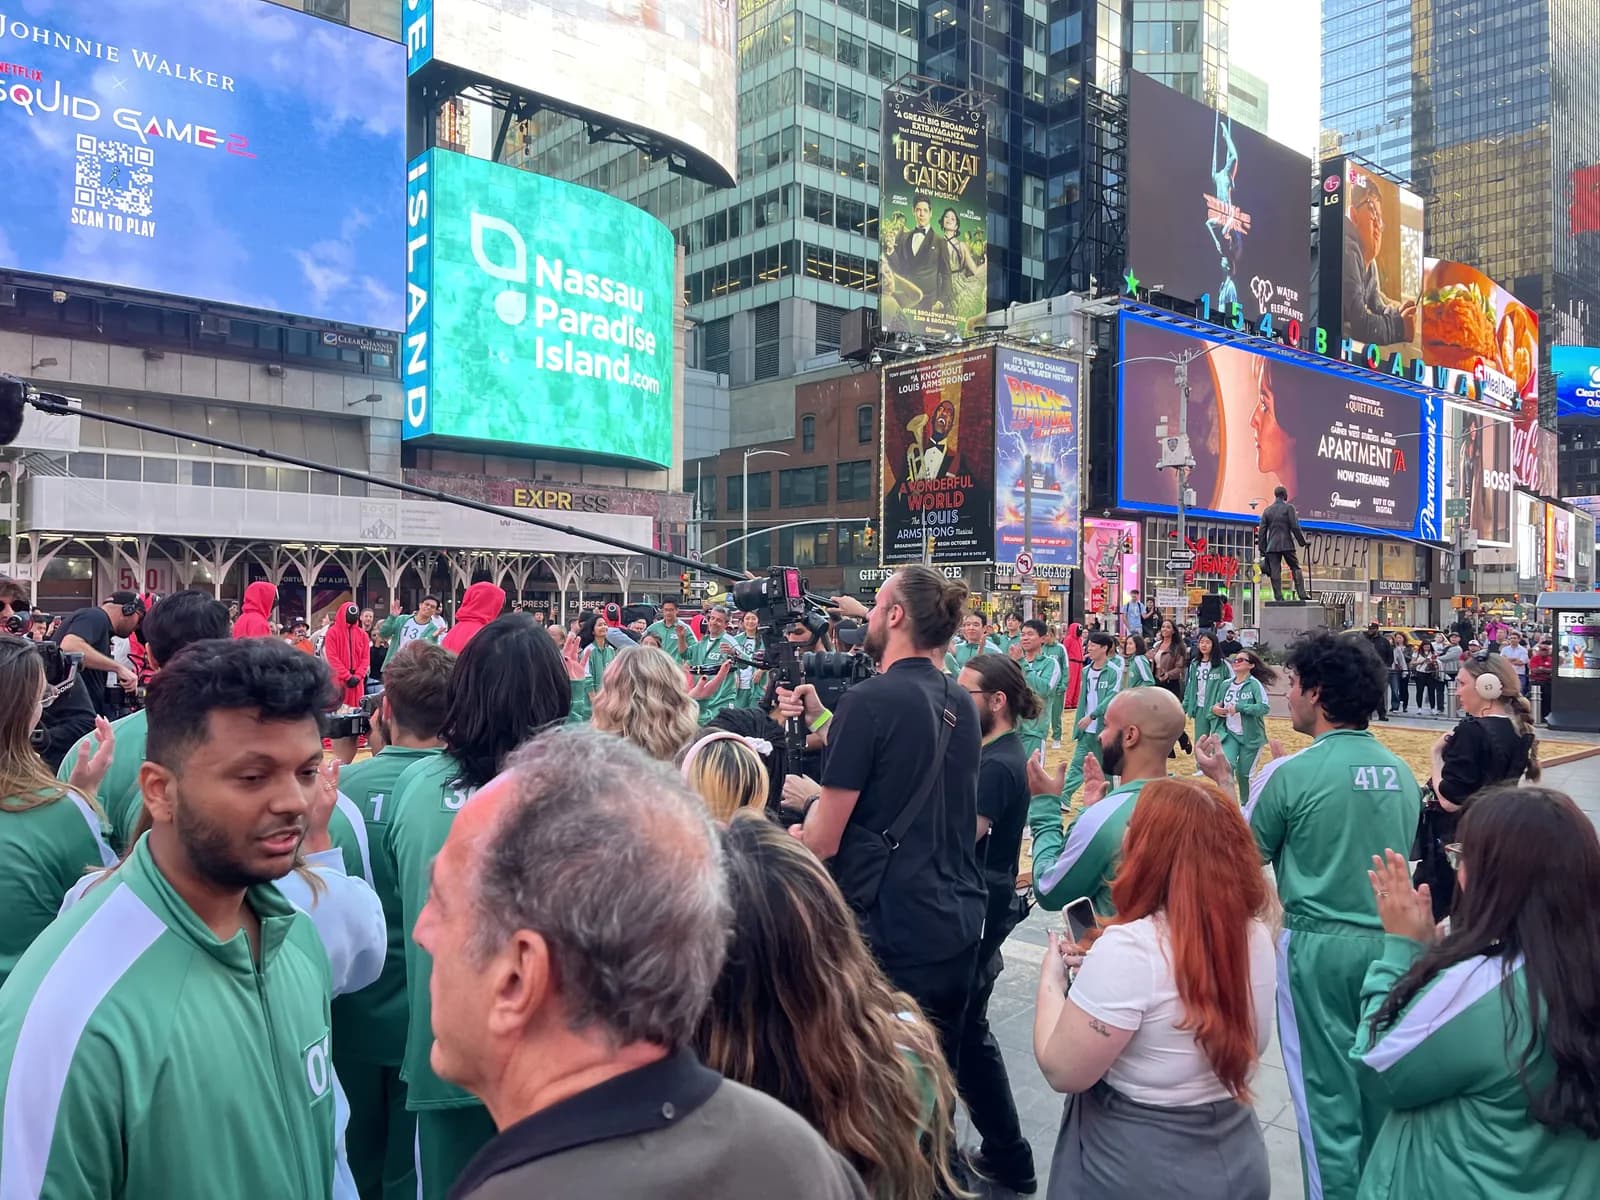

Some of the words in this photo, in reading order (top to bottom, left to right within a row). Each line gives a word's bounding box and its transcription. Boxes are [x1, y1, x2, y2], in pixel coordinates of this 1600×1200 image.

[0, 13, 119, 63] JOHNNIE
[131, 48, 235, 93] WALKER
[0, 79, 101, 121] SQUID
[112, 108, 225, 151] GAME
[911, 122, 965, 141] EXTRAVAGANZA
[928, 117, 940, 127] BIG
[940, 120, 978, 136] BROADWAY
[895, 139, 922, 164] THE
[926, 146, 980, 177] GREAT
[903, 163, 971, 195] GATSBY
[1356, 173, 1367, 188] LG
[934, 191, 960, 202] MUSICAL
[1324, 193, 1339, 206] LG
[71, 207, 104, 230] SCAN
[107, 212, 123, 233] TO
[127, 216, 156, 238] PLAY
[407, 161, 428, 429] ISLAND
[535, 254, 644, 314] Nassau
[1276, 285, 1299, 303] WATER
[1270, 303, 1304, 322] ELEPHANTS
[535, 295, 656, 356] Paradise
[921, 366, 962, 381] KNOCKOUT
[1003, 361, 1028, 374] MUSICAL
[1052, 372, 1075, 383] HISTORY
[898, 383, 920, 394] LOUIS
[1003, 374, 1072, 411] BACK
[1025, 407, 1072, 429] FUTURE
[1349, 400, 1367, 414] QUIET
[1367, 404, 1384, 417] PLACE
[1317, 434, 1393, 469] APARTMENT
[1393, 448, 1407, 475] 7A
[1337, 469, 1355, 482] NOW
[1355, 471, 1390, 488] STREAMING
[1420, 396, 1438, 540] Paramount+
[899, 483, 908, 494] A
[908, 475, 974, 492] WONDERFUL
[1483, 469, 1511, 492] BOSS
[514, 488, 609, 513] EXPRESS
[907, 491, 965, 511] WORLD
[1320, 591, 1347, 604] FOREVER
[1563, 615, 1585, 624] TSQ
[1354, 766, 1400, 790] 412
